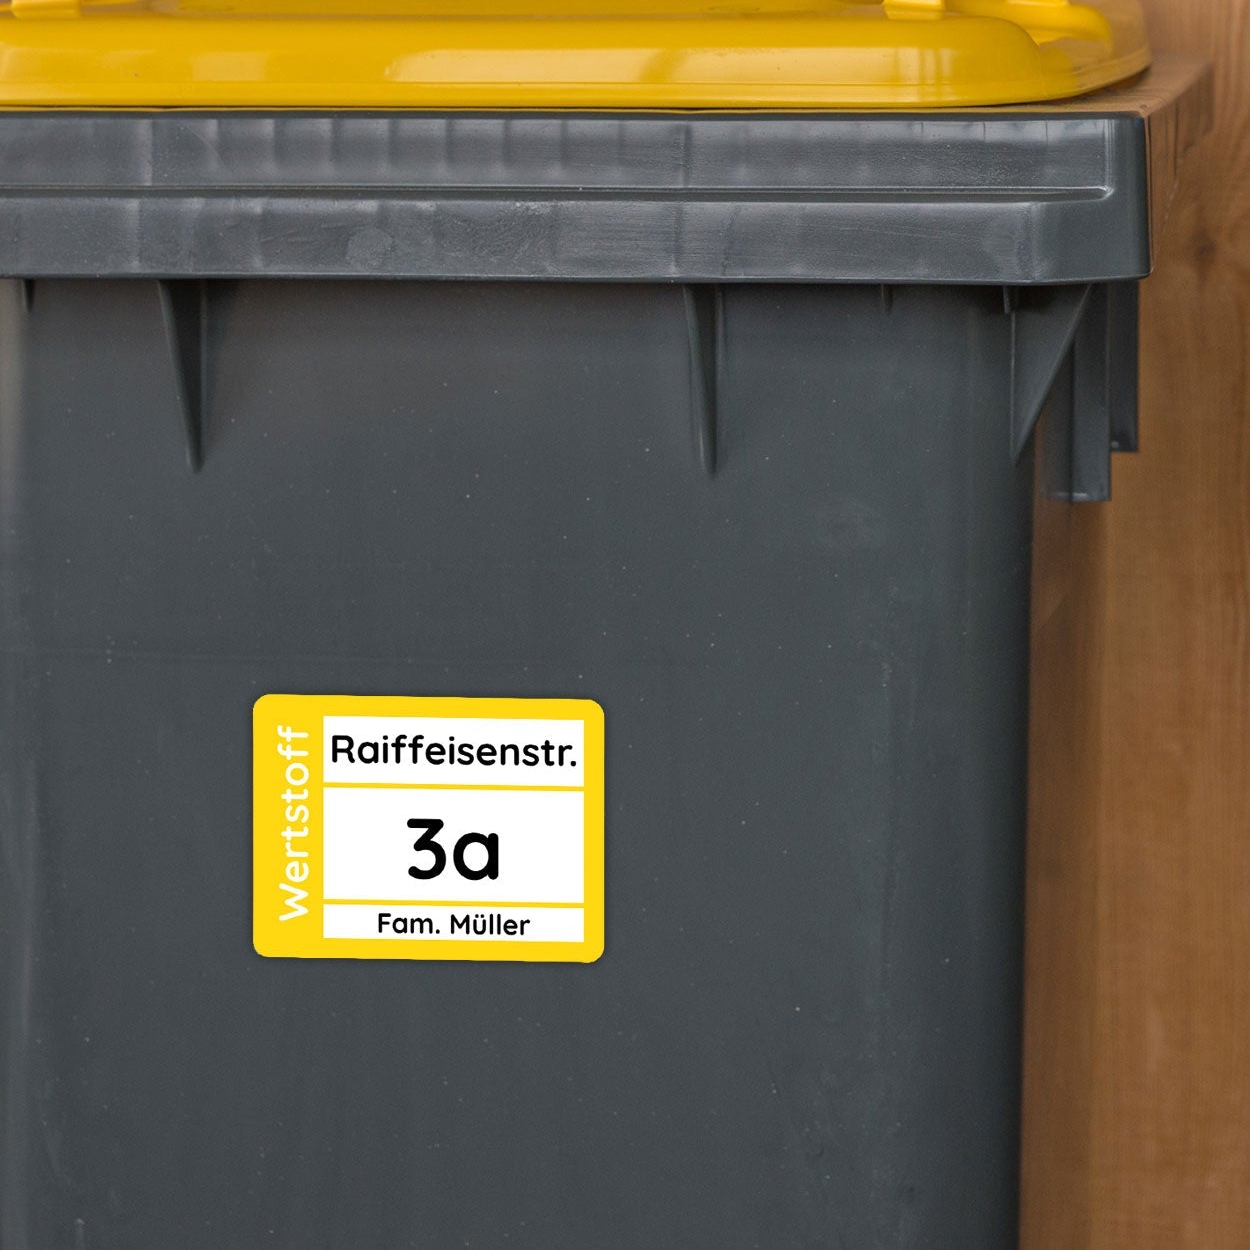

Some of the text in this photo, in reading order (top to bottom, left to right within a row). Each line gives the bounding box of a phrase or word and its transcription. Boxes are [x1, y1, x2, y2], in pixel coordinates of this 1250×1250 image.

[331, 734, 577, 767] Raiffeisenstr.
[277, 725, 310, 921] Wertstoff
[406, 818, 499, 881] 3a
[378, 912, 531, 935] Fam. Müller
